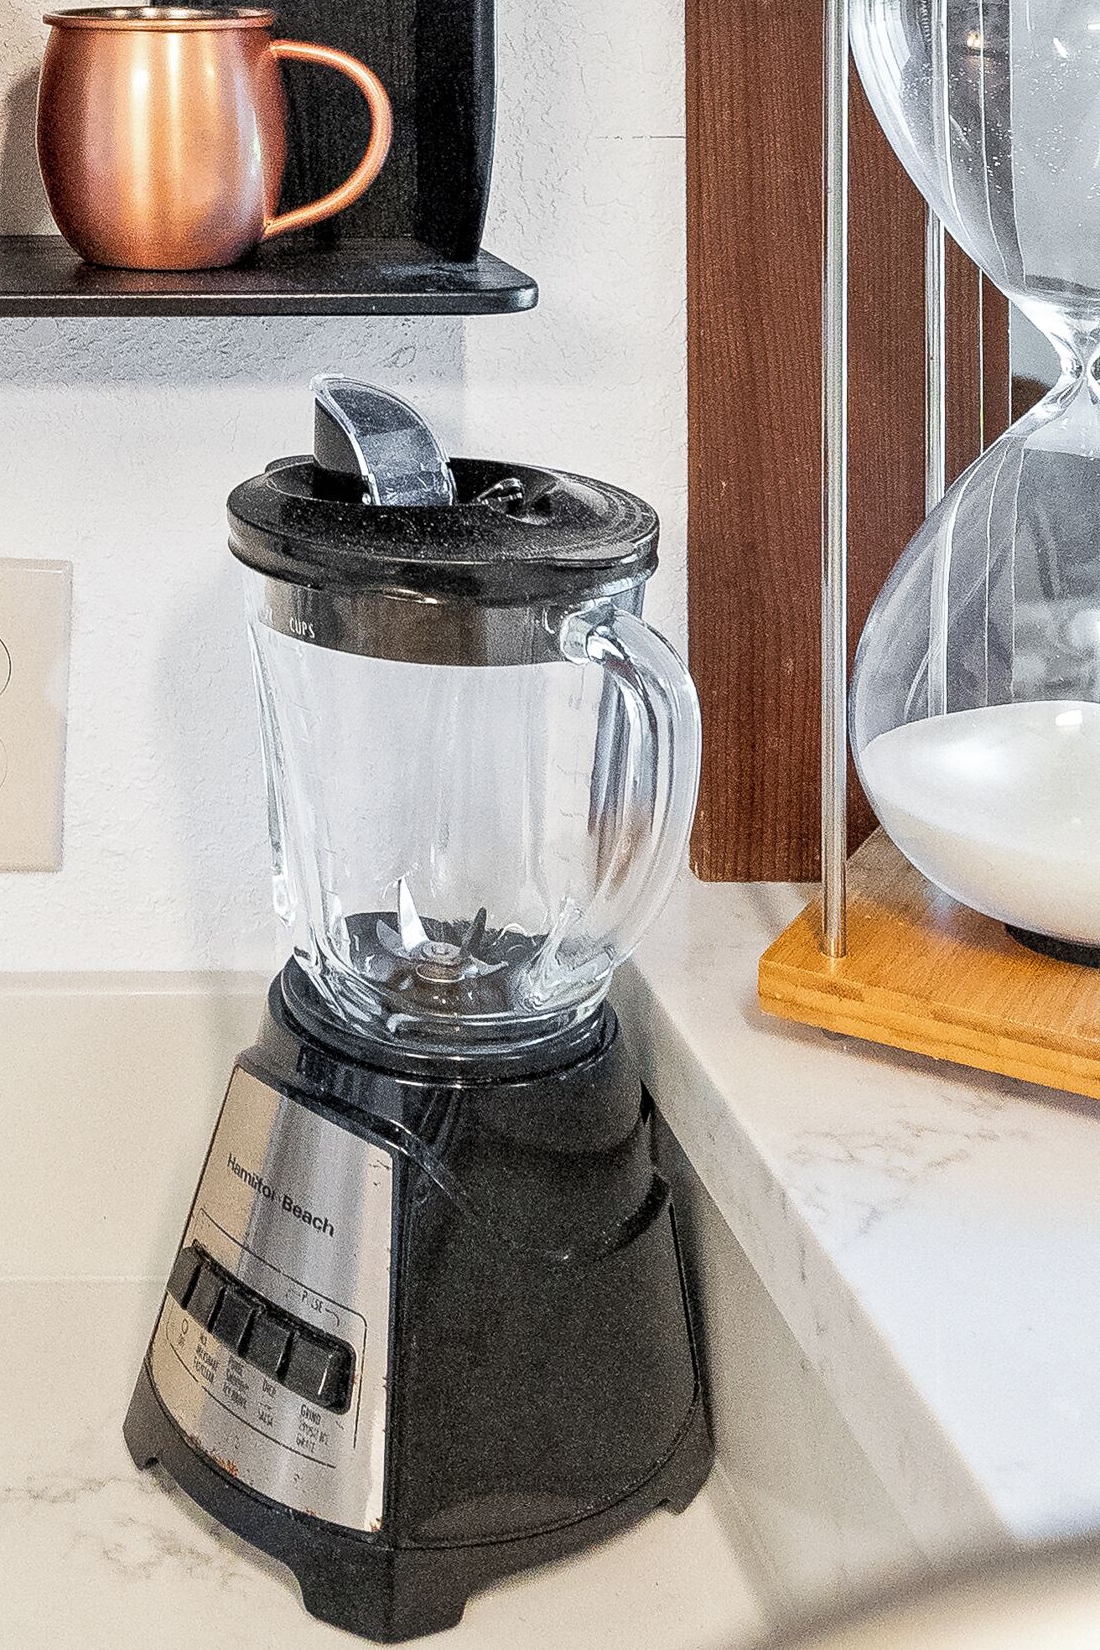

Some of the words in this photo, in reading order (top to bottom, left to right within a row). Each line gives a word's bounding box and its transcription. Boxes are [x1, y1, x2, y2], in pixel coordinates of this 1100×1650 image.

[289, 616, 315, 639] CUPS
[281, 1194, 335, 1237] Beach
[301, 1290, 325, 1313] PLSE
